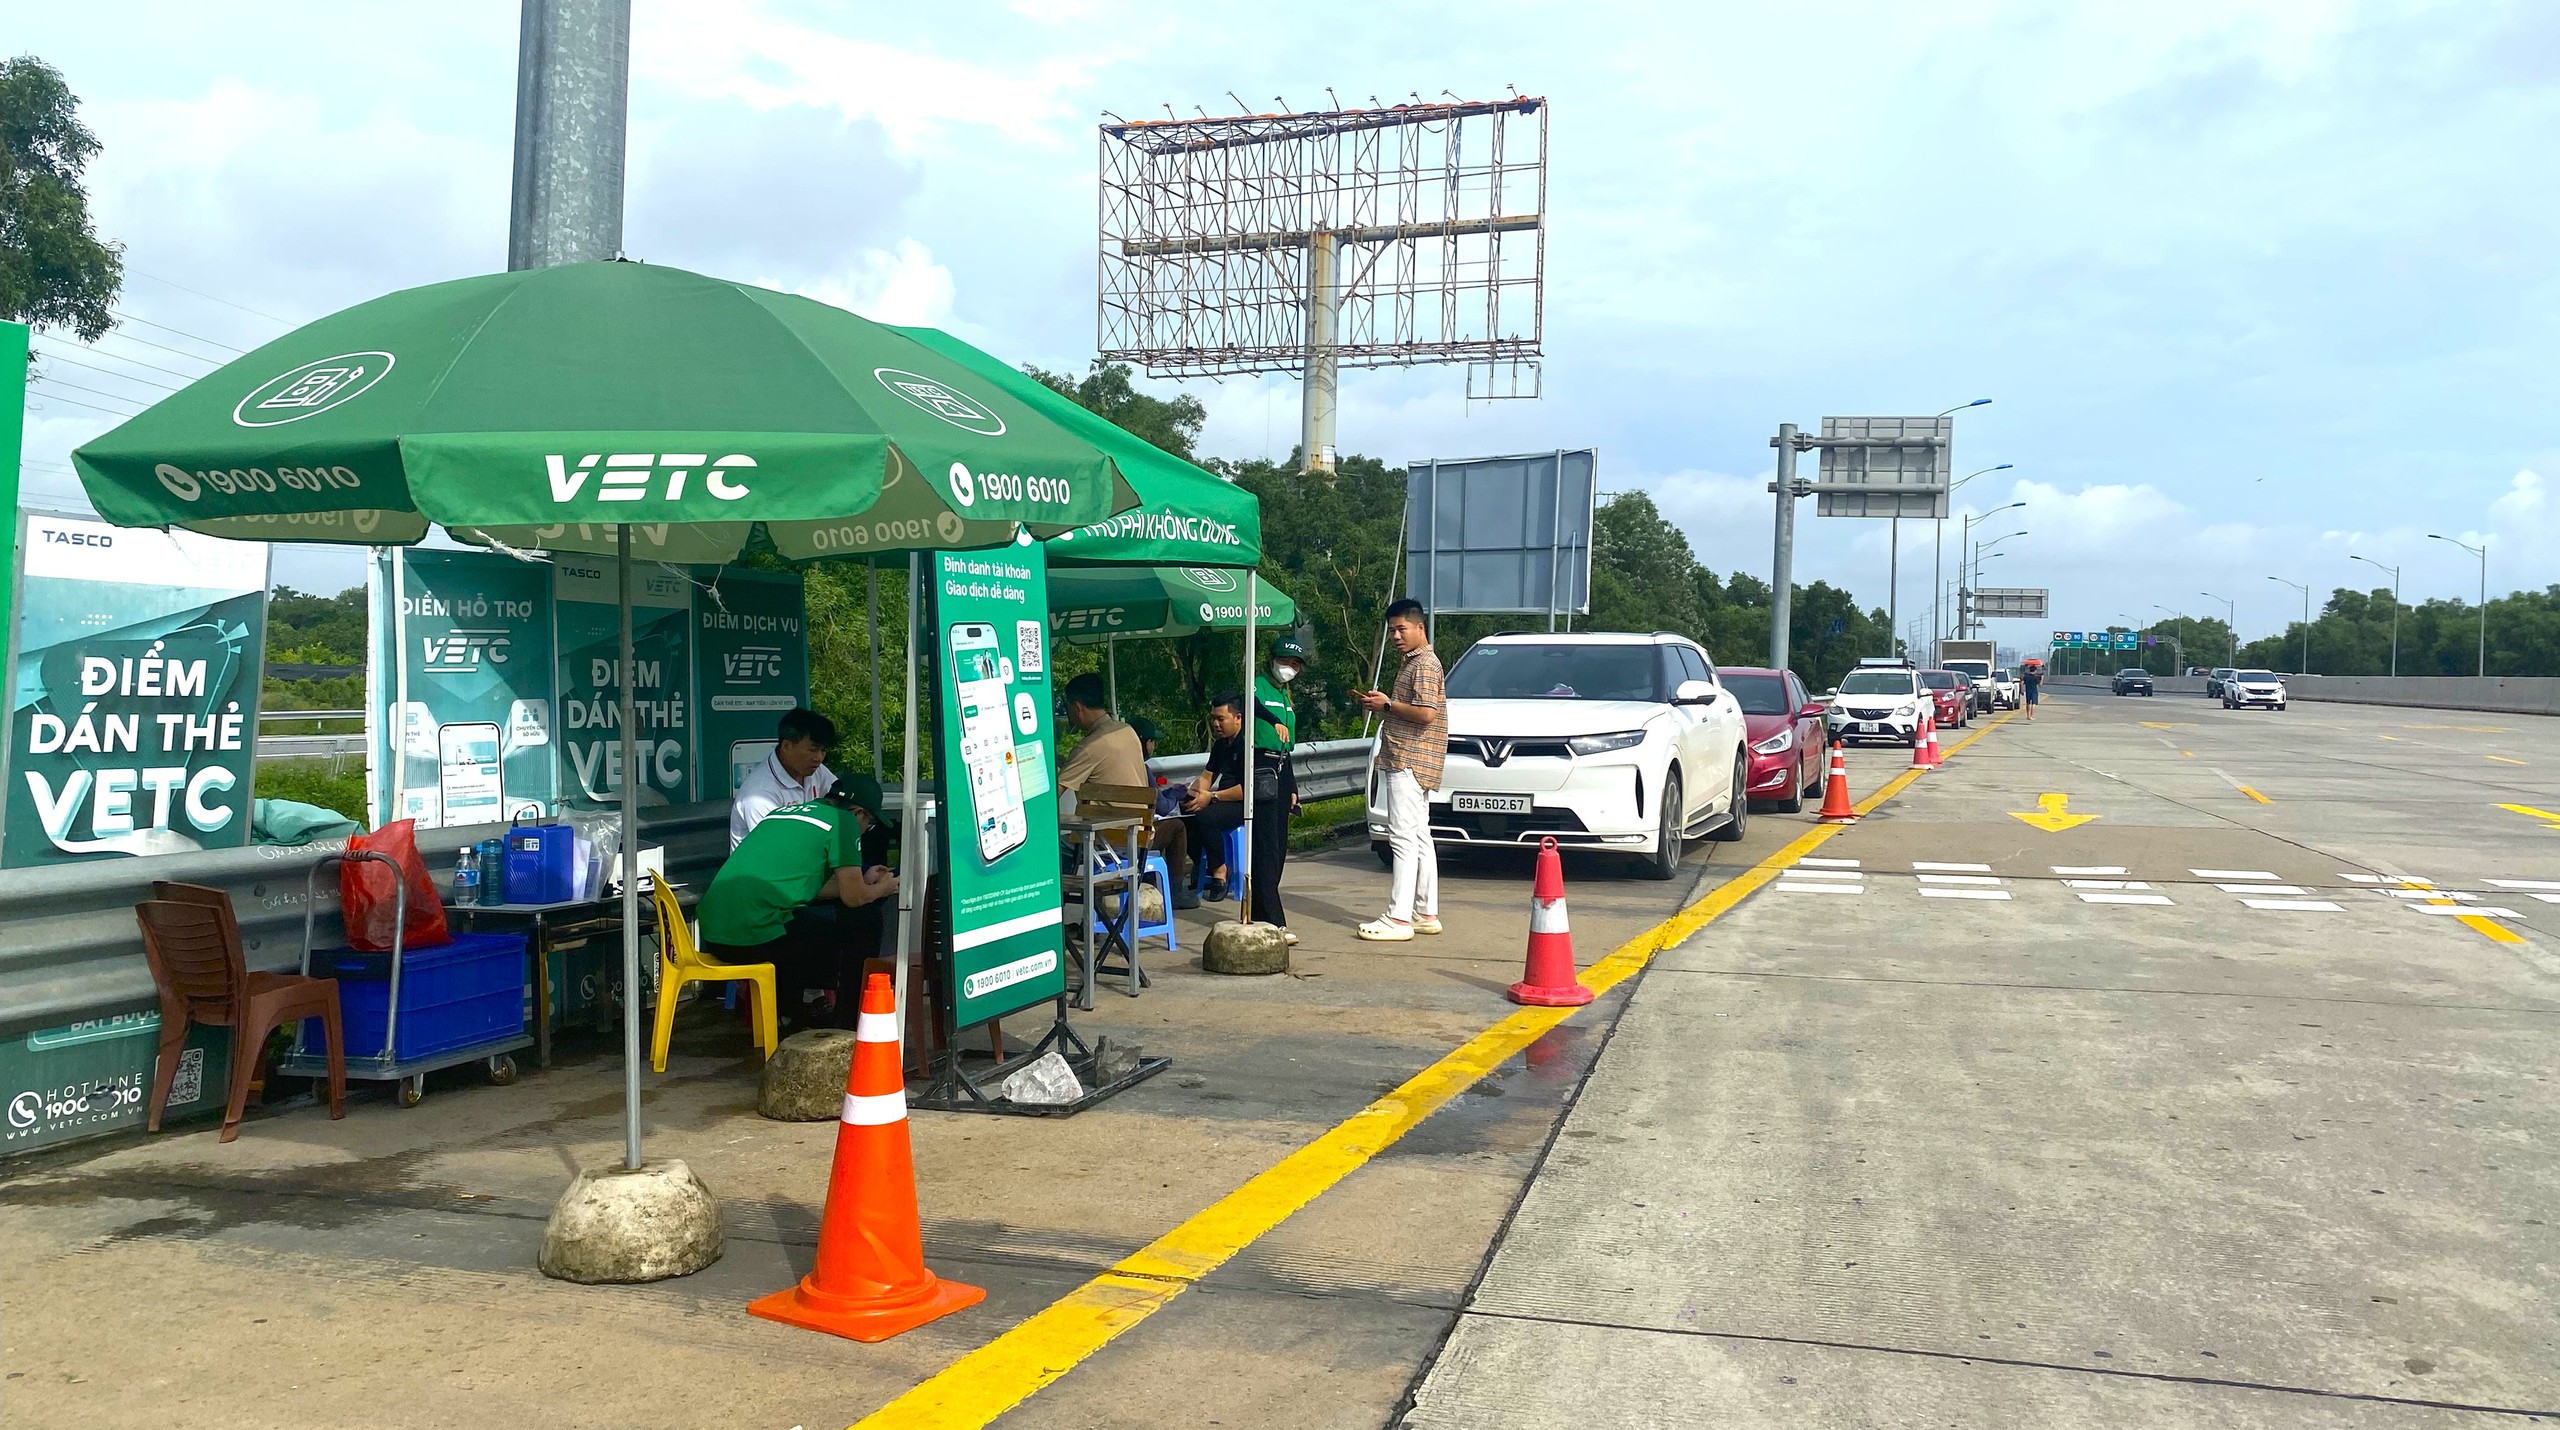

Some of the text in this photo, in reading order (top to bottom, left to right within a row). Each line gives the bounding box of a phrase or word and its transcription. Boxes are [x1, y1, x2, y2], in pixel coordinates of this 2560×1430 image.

[197, 466, 361, 495] 1900 6010
[545, 453, 758, 502] VETC
[977, 473, 1070, 505] 1900 6010
[1145, 508, 1198, 542] KHÔNG
[42, 529, 113, 549] TASCO
[561, 566, 602, 579] TASCO
[944, 556, 967, 576] Định
[968, 560, 991, 577] danh
[993, 563, 1004, 577] tài
[645, 578, 681, 594] VETC
[945, 580, 968, 597] Giao
[969, 585, 988, 601] dịch
[1003, 586, 1025, 604] dàng
[494, 600, 533, 622] TRỢ
[1049, 607, 1125, 630] VETC
[1215, 606, 1243, 619] 1900
[743, 615, 777, 635] DỊCH
[780, 616, 799, 637] VỤ
[422, 637, 511, 664] VETC
[1285, 642, 1303, 653] VETC
[80, 640, 208, 697] ĐIỂM
[723, 653, 782, 677] VETC
[29, 701, 245, 754] DÁN THẺ
[24, 765, 237, 840] VETC
[1458, 797, 1524, 811] 89A-602.67
